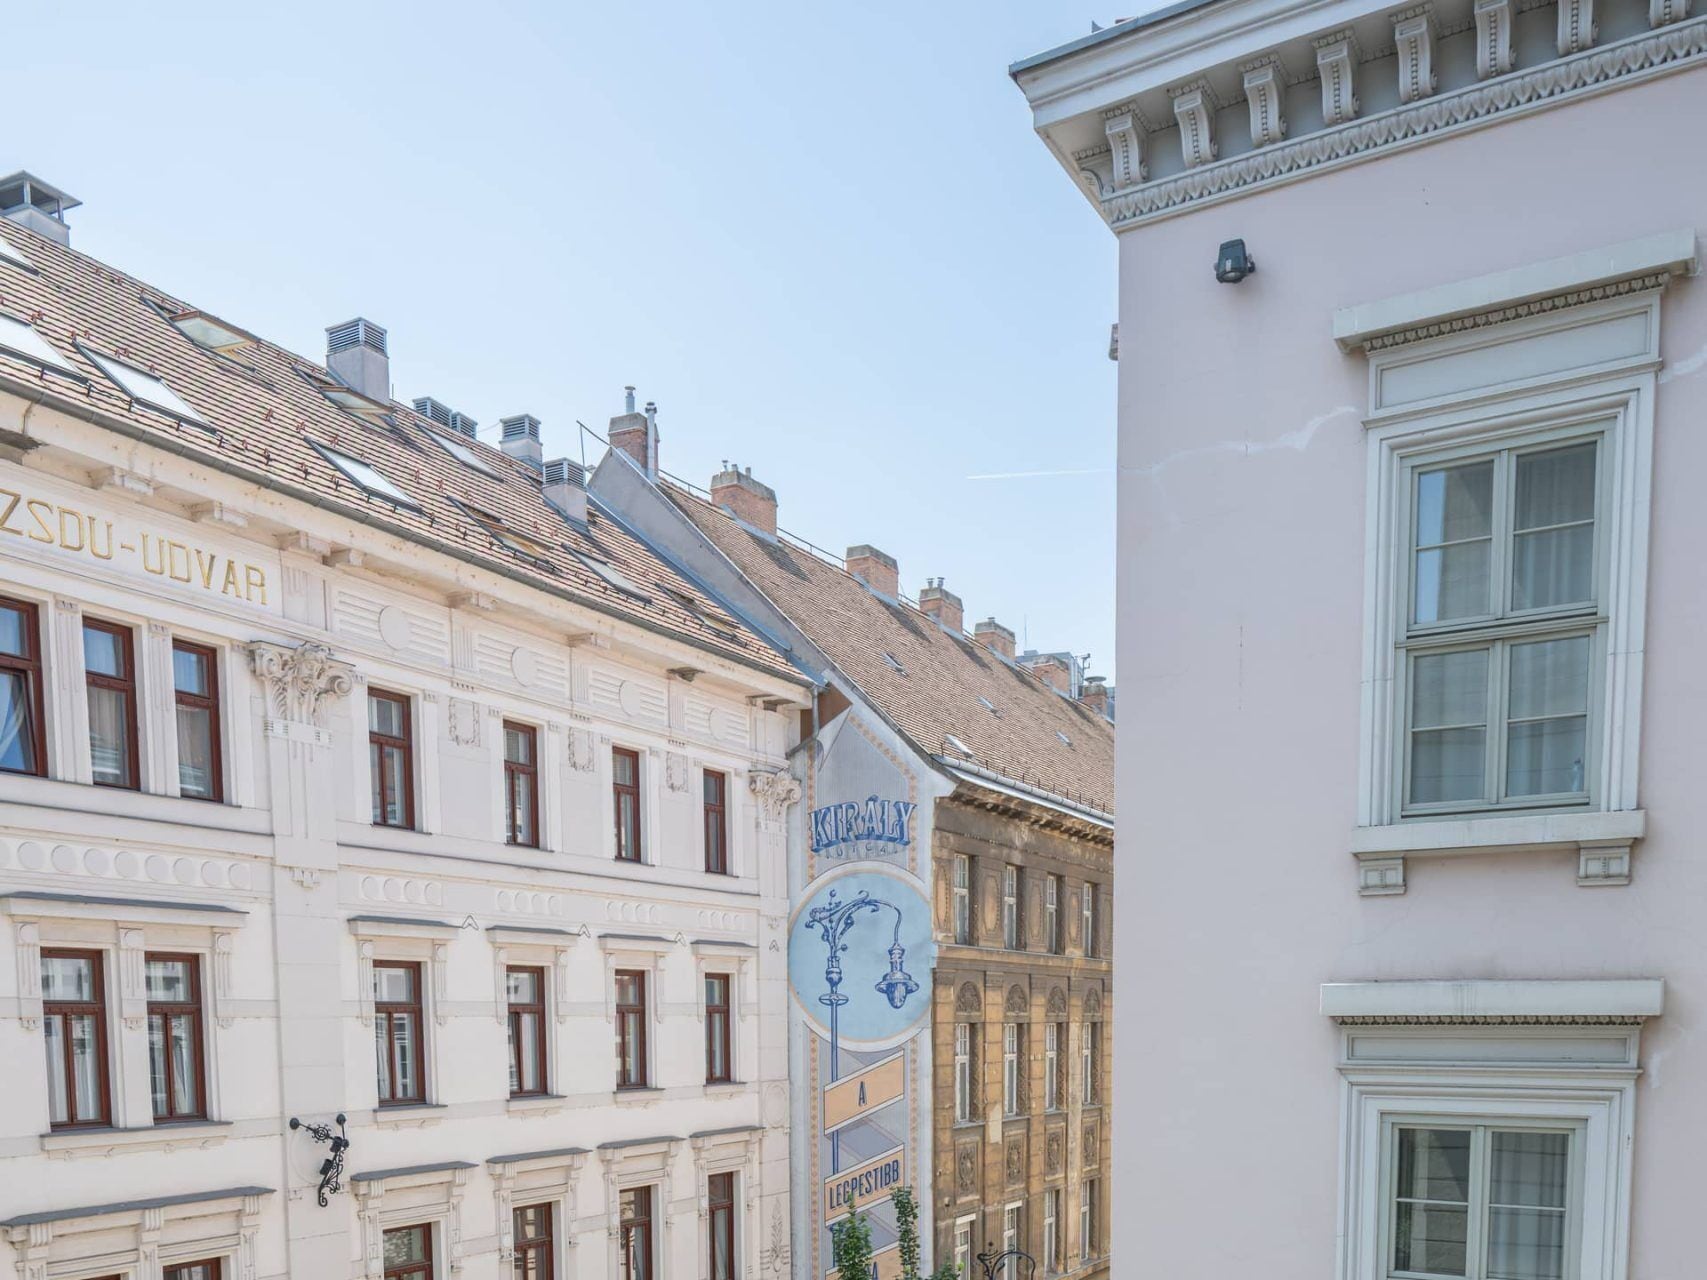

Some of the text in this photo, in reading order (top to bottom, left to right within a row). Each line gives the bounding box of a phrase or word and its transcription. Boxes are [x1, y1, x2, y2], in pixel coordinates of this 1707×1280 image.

[808, 794, 917, 853] KIRÁLY
[857, 1081, 867, 1107] A
[829, 1159, 899, 1210] LEGPESTIBB
